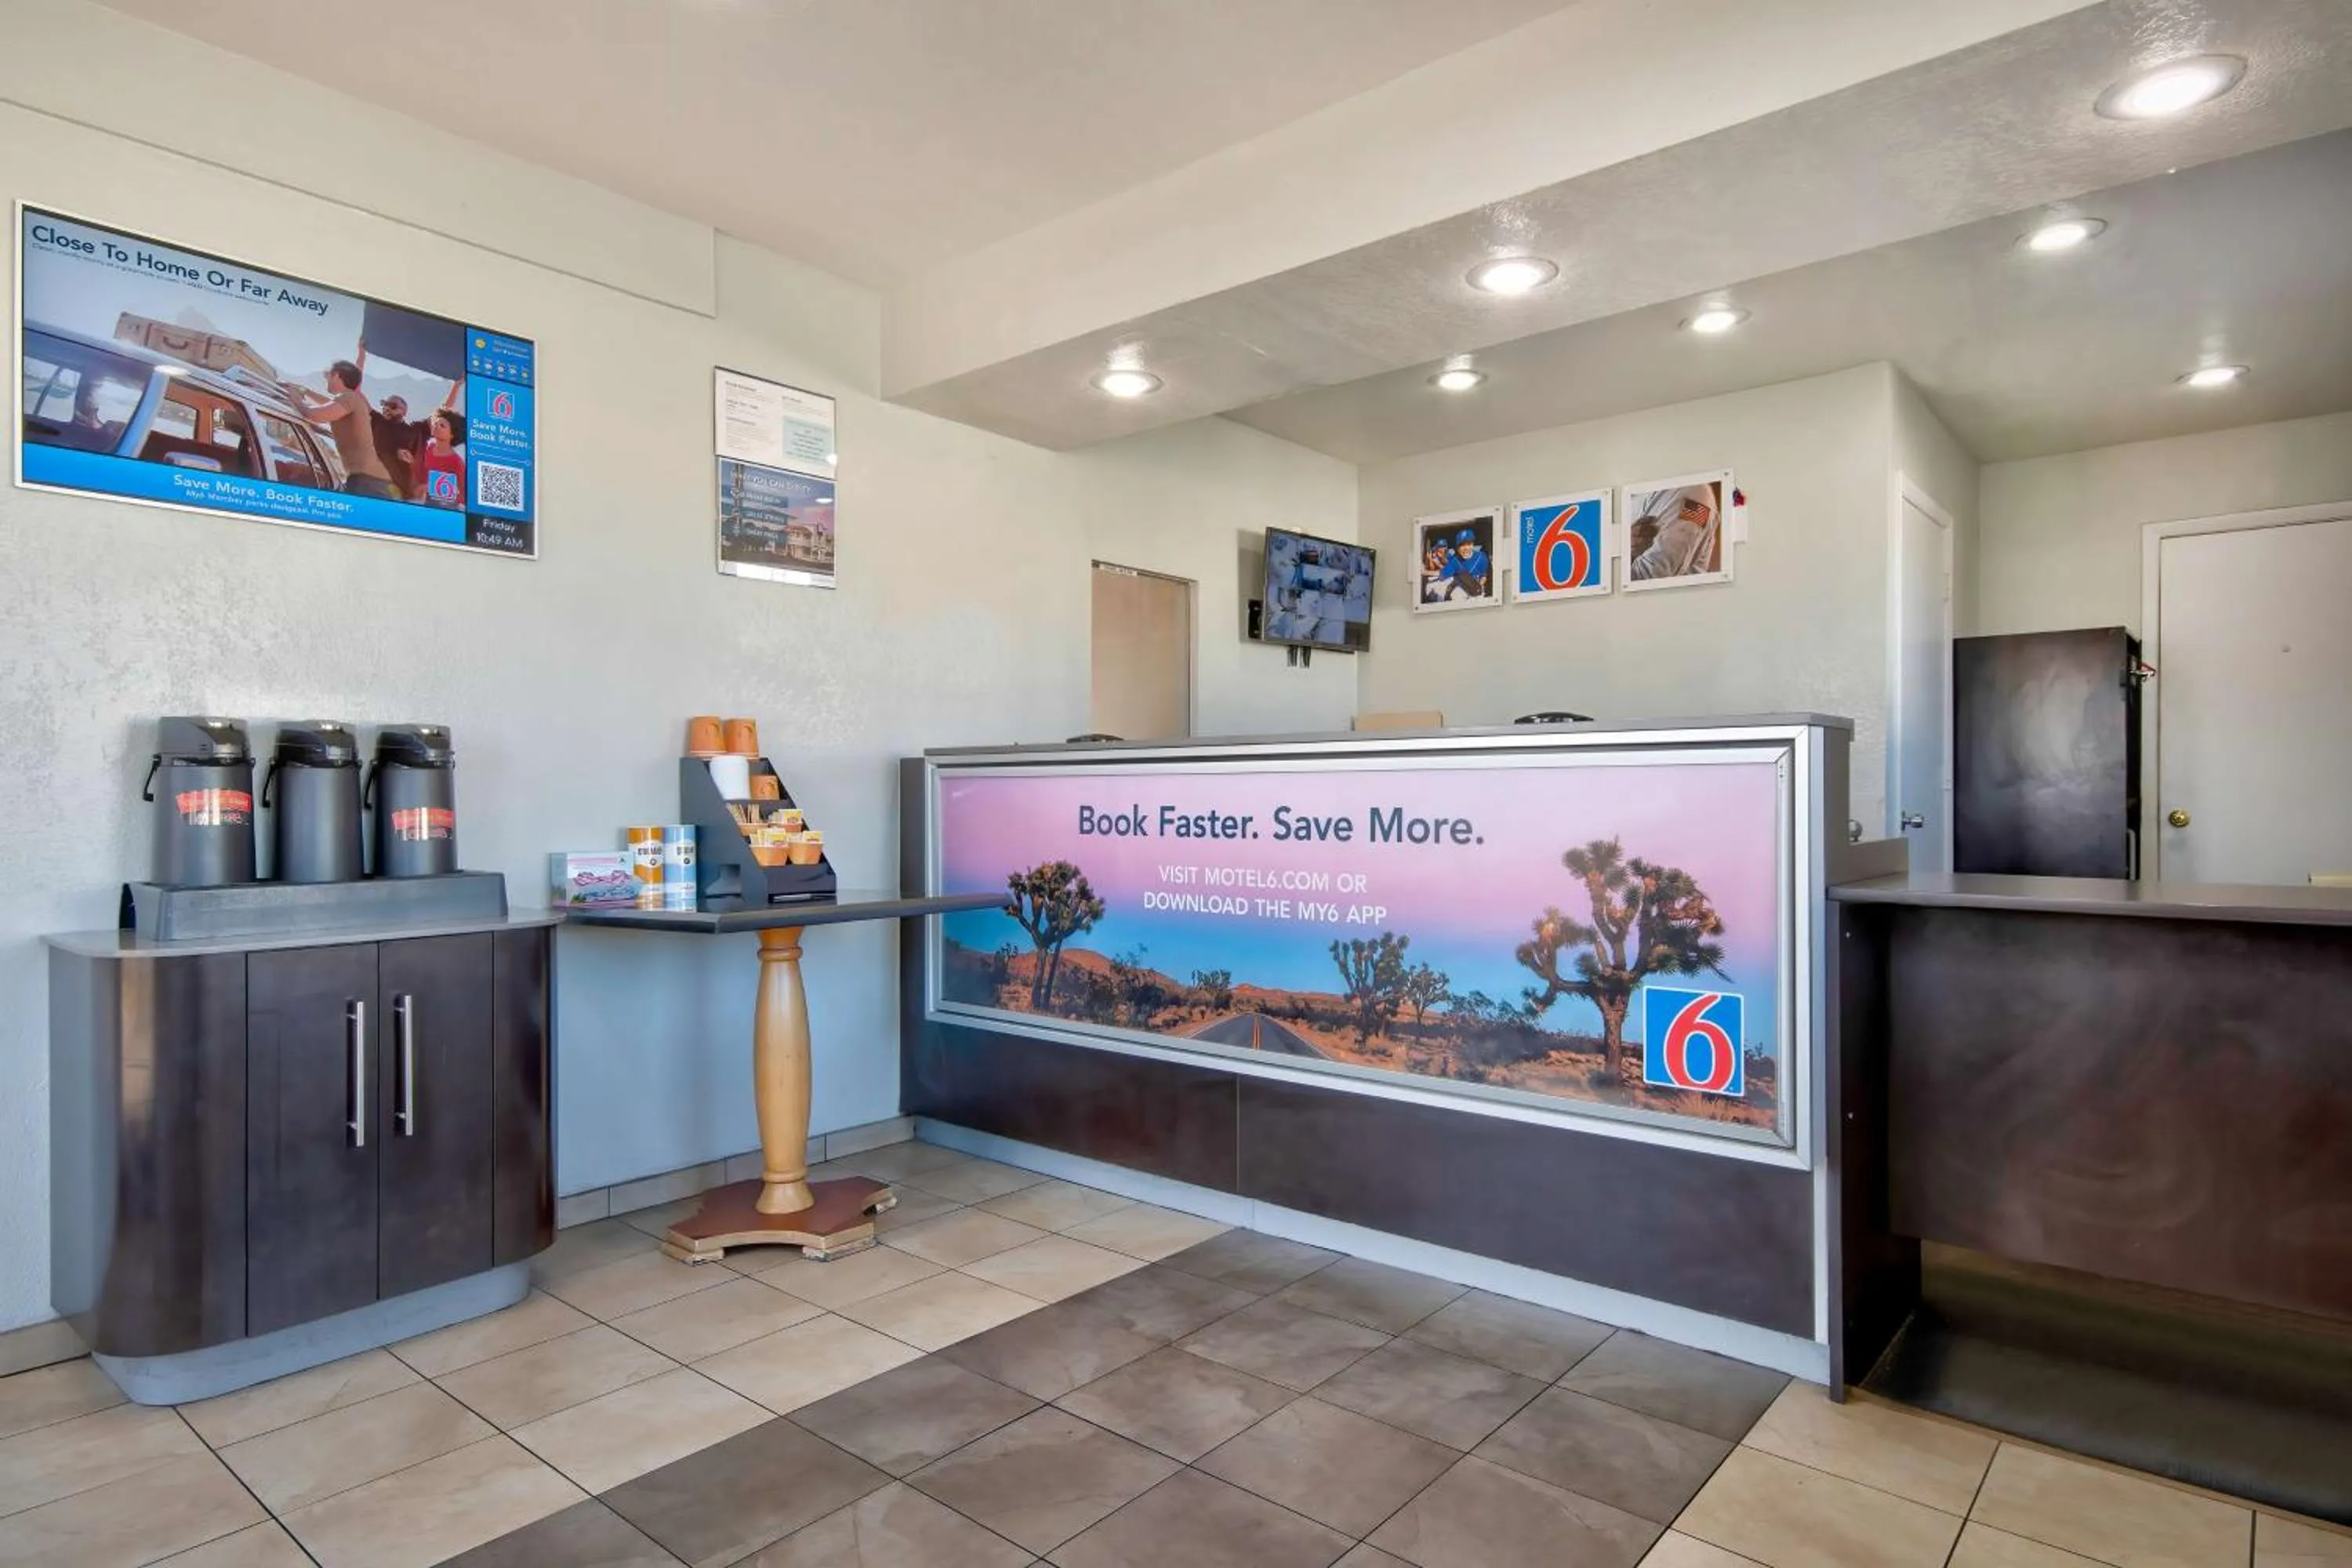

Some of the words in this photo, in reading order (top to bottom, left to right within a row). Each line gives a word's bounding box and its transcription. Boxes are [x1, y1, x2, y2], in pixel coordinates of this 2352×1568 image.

[32, 225, 94, 253] Close
[102, 242, 128, 262] To
[137, 251, 199, 279] Home
[207, 270, 234, 288] Or
[241, 278, 271, 298] Far
[278, 289, 328, 315] Away
[470, 430, 495, 441] Book
[472, 419, 495, 431] Save
[174, 474, 209, 490] Save
[216, 481, 260, 499] More.
[267, 488, 302, 506] Book
[308, 495, 354, 513] Faster.
[477, 532, 502, 546] 10:49
[505, 537, 523, 548] AM
[482, 518, 515, 532] Friday
[1534, 504, 1590, 591] 6
[1079, 804, 1149, 837] Book
[1159, 805, 1259, 840] Faster.
[1272, 806, 1353, 842] Save
[1369, 807, 1484, 845] More.
[1158, 865, 1199, 885] VISIT
[1205, 868, 1329, 892] MOTEL6.COM
[1337, 873, 1367, 894] OR
[1144, 891, 1248, 916] DOWNLOAD
[1254, 899, 1290, 918] THE
[1298, 902, 1338, 923] MY6
[1347, 905, 1387, 926] APP
[1663, 991, 1736, 1093] 6
